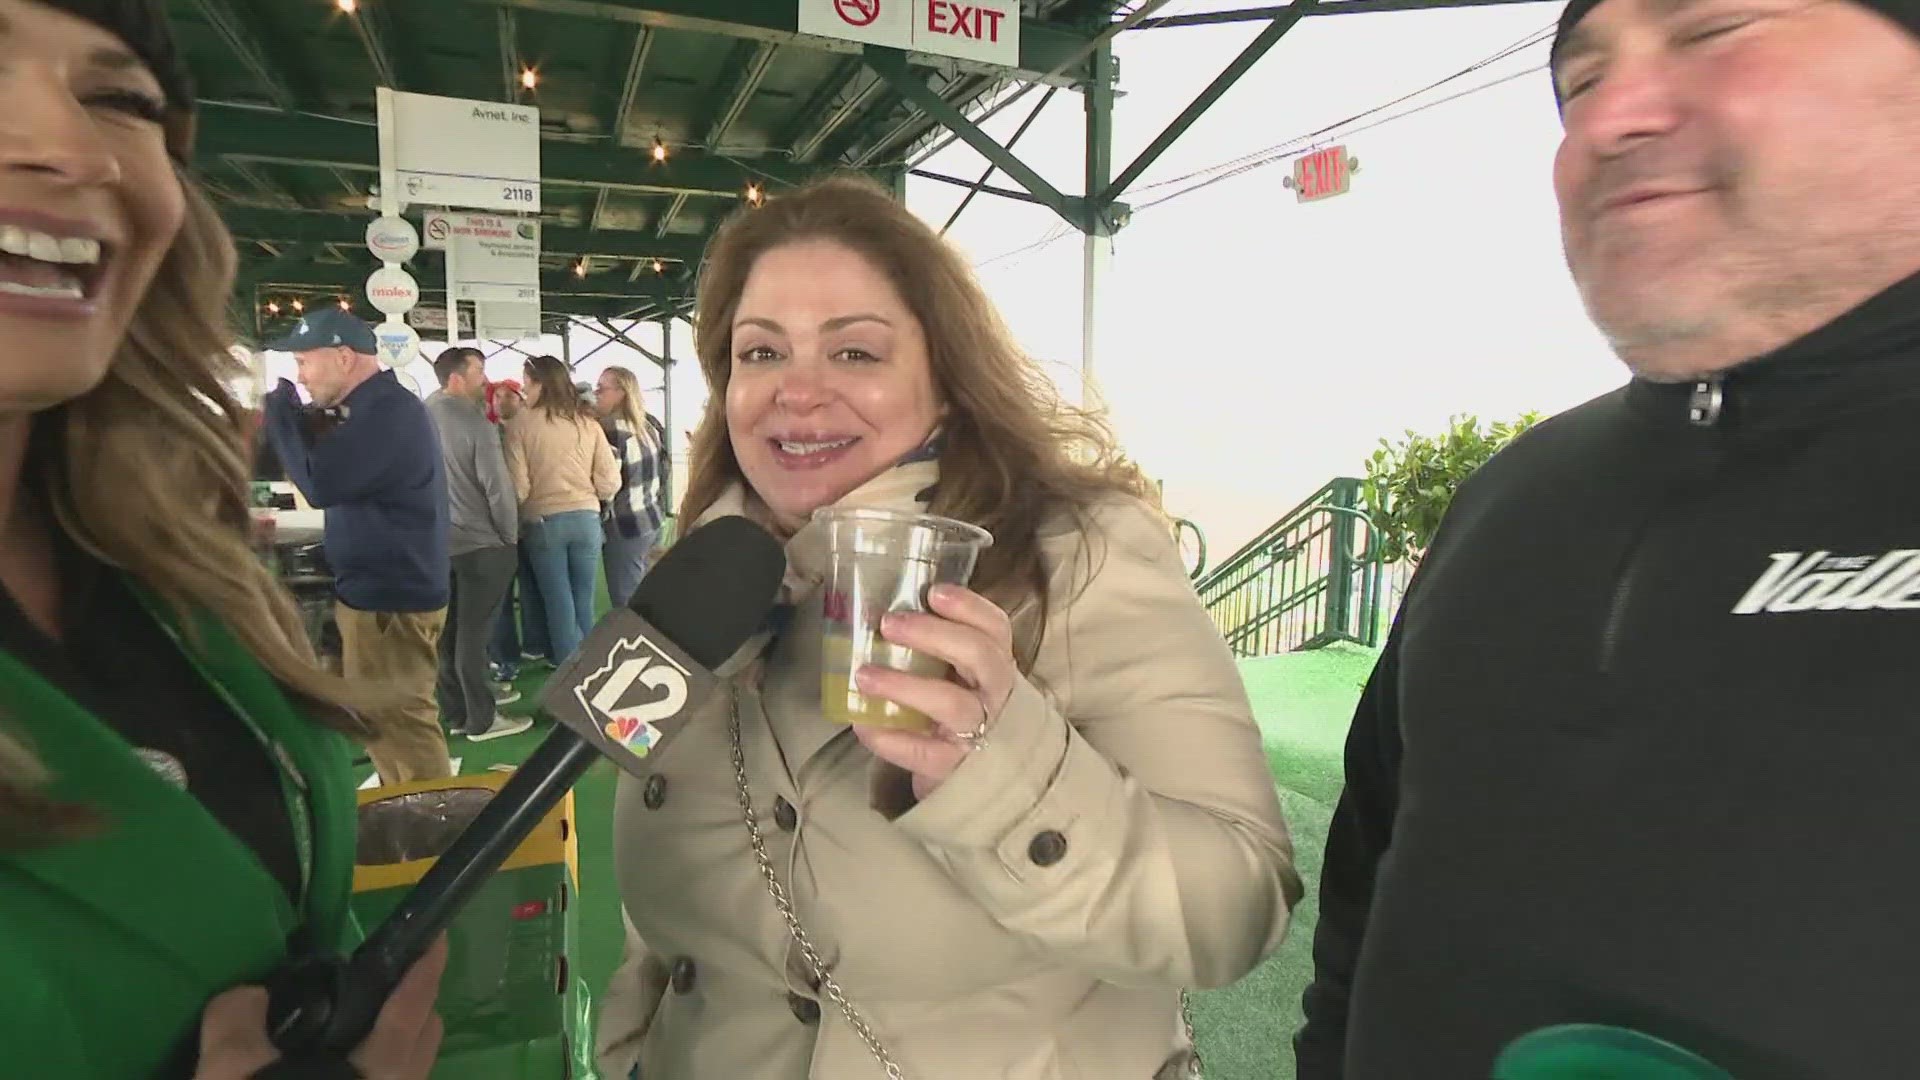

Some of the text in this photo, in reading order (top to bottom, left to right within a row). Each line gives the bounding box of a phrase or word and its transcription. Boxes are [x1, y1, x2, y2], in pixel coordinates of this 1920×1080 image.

[927, 0, 1006, 43] EXIT
[503, 188, 533, 202] 2118
[1301, 149, 1342, 198] EXIT
[371, 286, 412, 298] molex
[590, 656, 688, 751] 12
